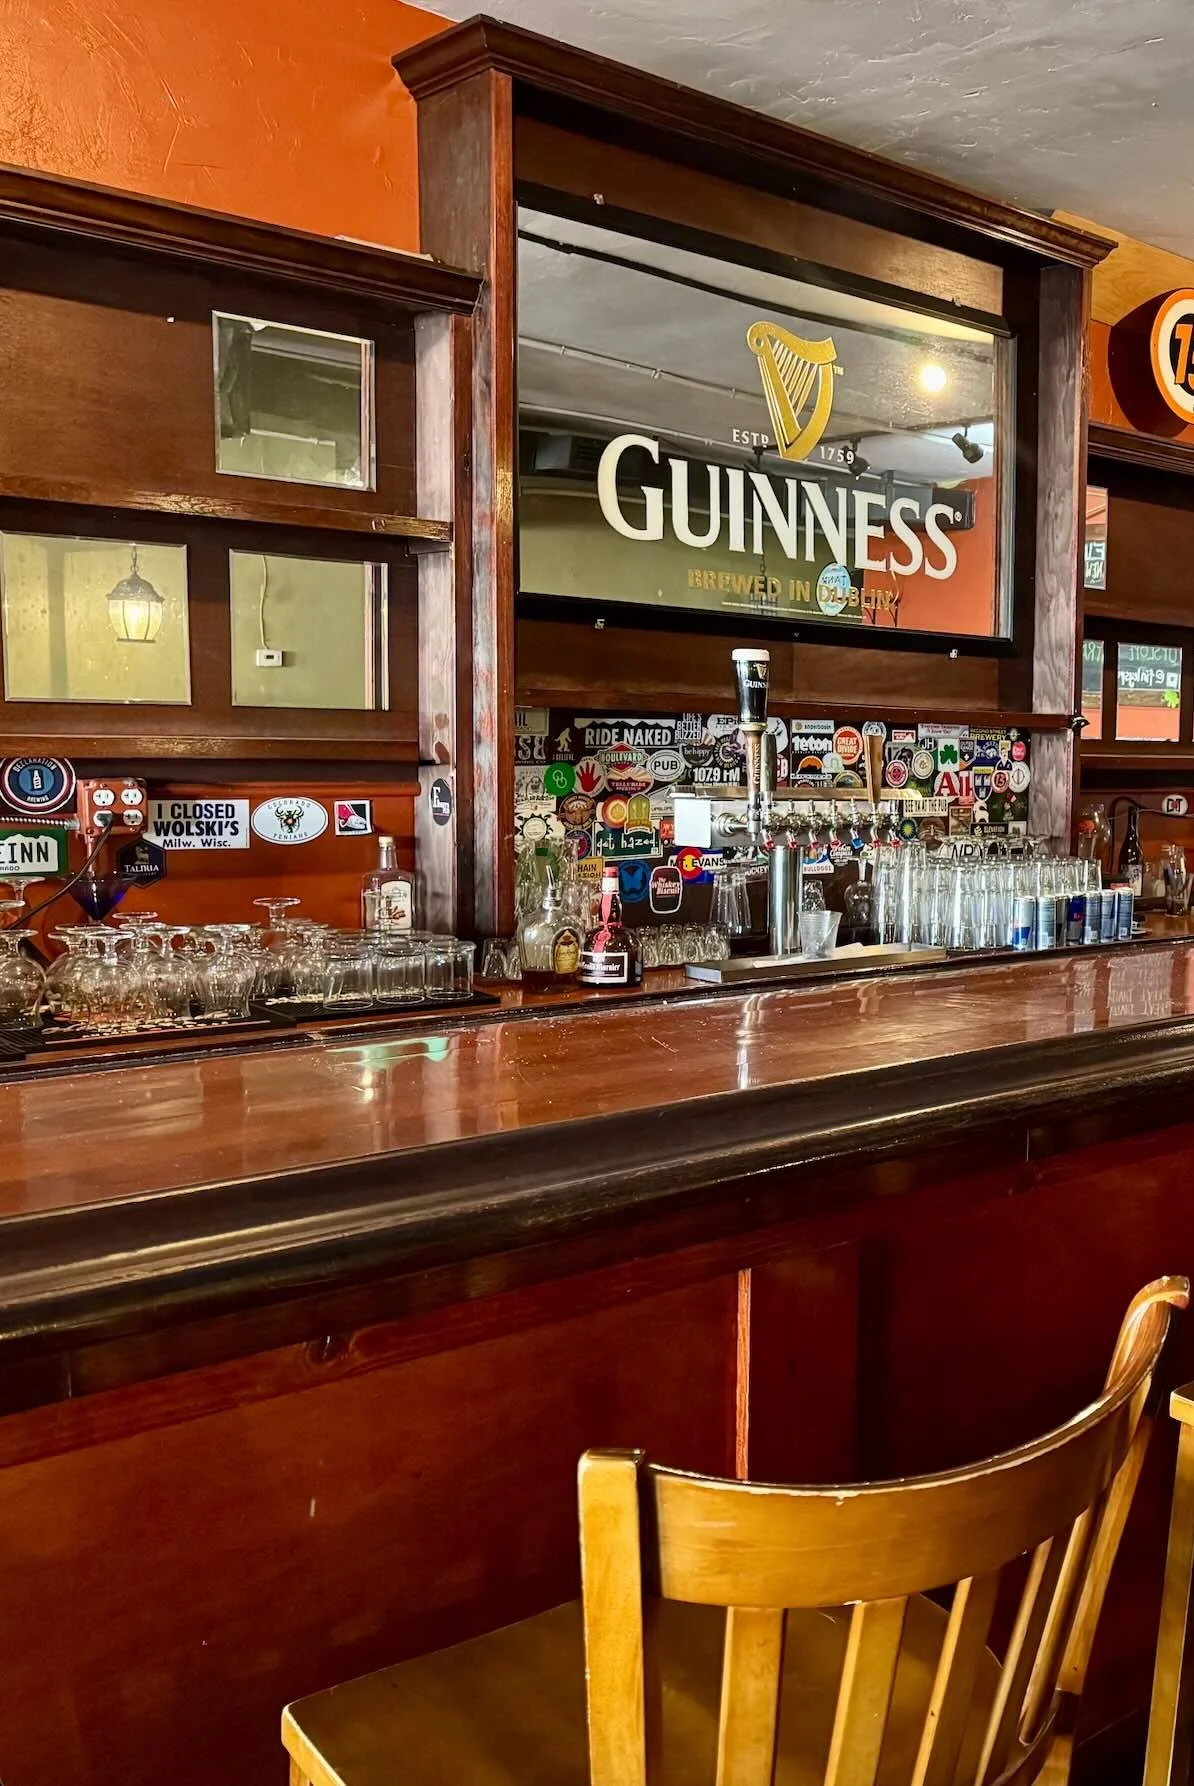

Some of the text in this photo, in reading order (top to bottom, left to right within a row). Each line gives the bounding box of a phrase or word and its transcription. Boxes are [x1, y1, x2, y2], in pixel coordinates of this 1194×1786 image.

[820, 446, 855, 464] 1759
[597, 434, 958, 580] GUINNESS
[687, 568, 784, 597] BREWED
[788, 579, 811, 602] IN
[585, 728, 672, 746] RIDE NAKED
[653, 761, 679, 771] PUB
[693, 767, 721, 781] 107.9
[157, 803, 235, 820] I CLOSED
[153, 820, 240, 837] WOLSKI'S
[162, 838, 232, 848] Milw. Wisc.
